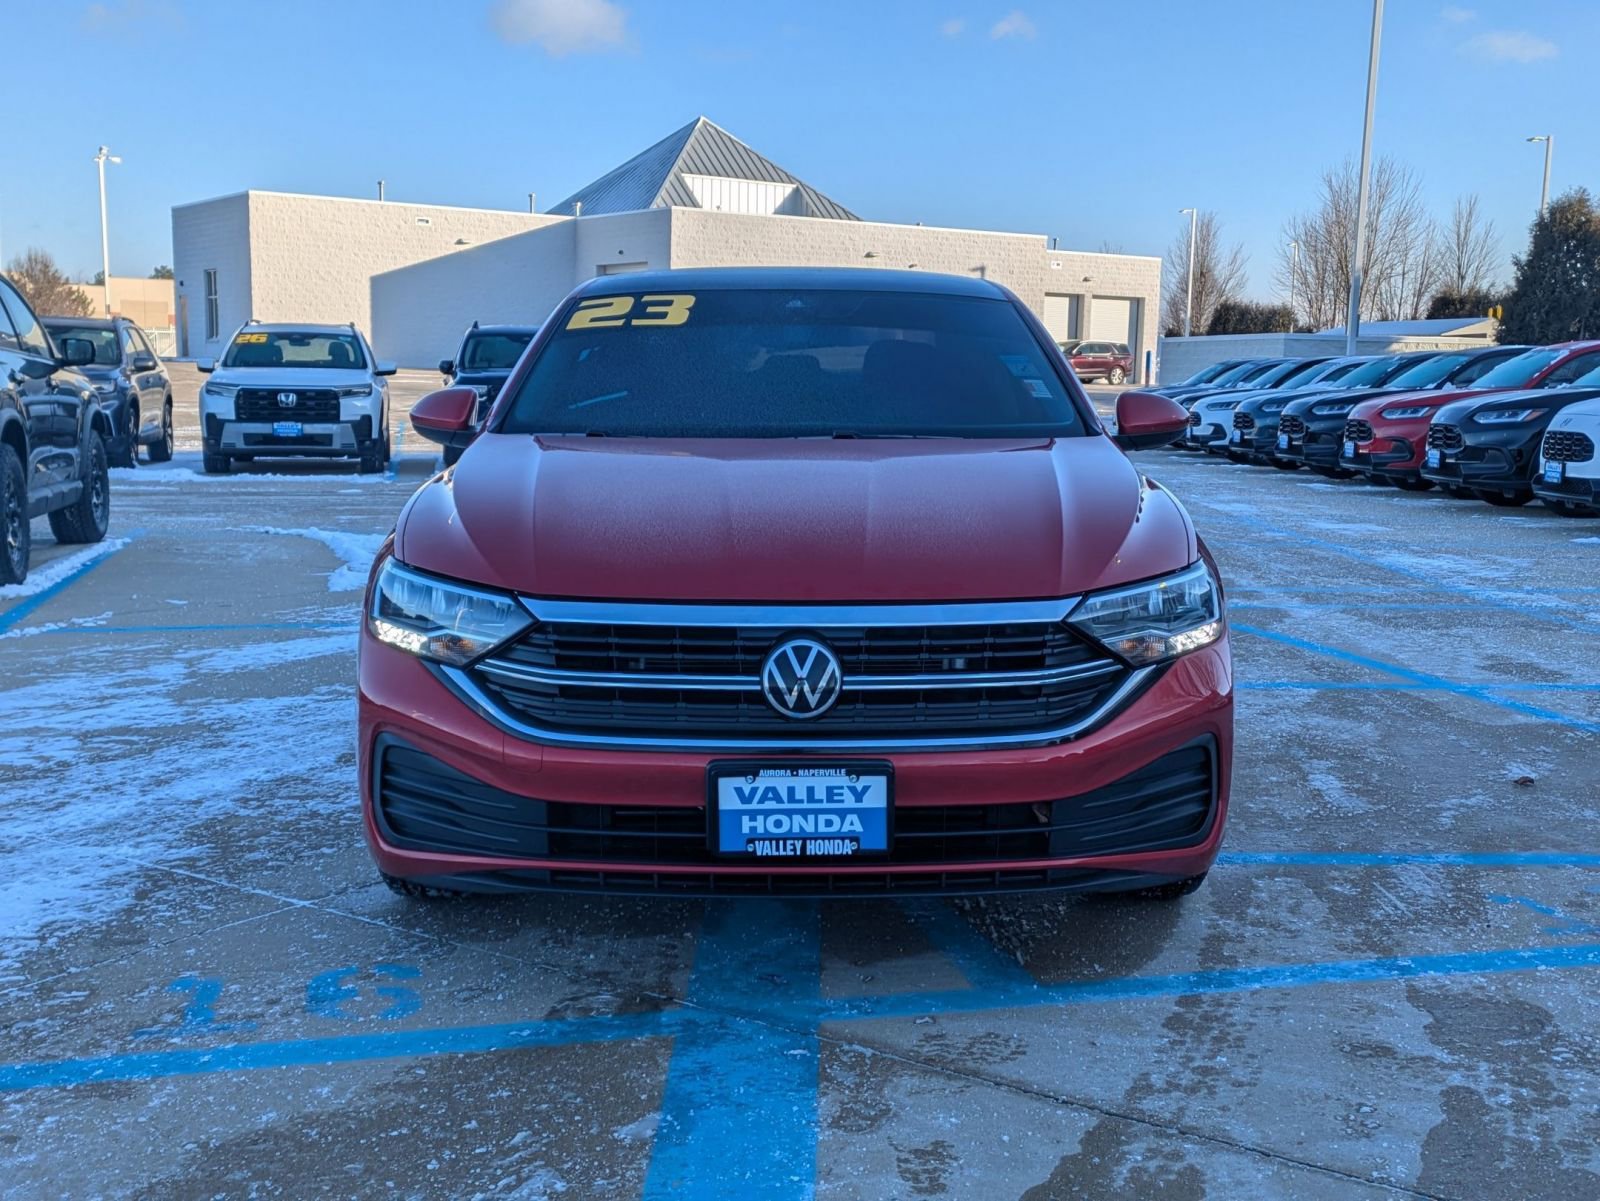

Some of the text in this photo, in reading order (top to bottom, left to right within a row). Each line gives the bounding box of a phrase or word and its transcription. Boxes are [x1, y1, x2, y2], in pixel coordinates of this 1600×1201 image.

[565, 294, 696, 330] 23
[759, 768, 847, 777] AURORA NAPERVILLE
[733, 785, 872, 805] VALLEY
[741, 814, 864, 833] HONDA
[755, 839, 852, 856] VALLEY HONDA
